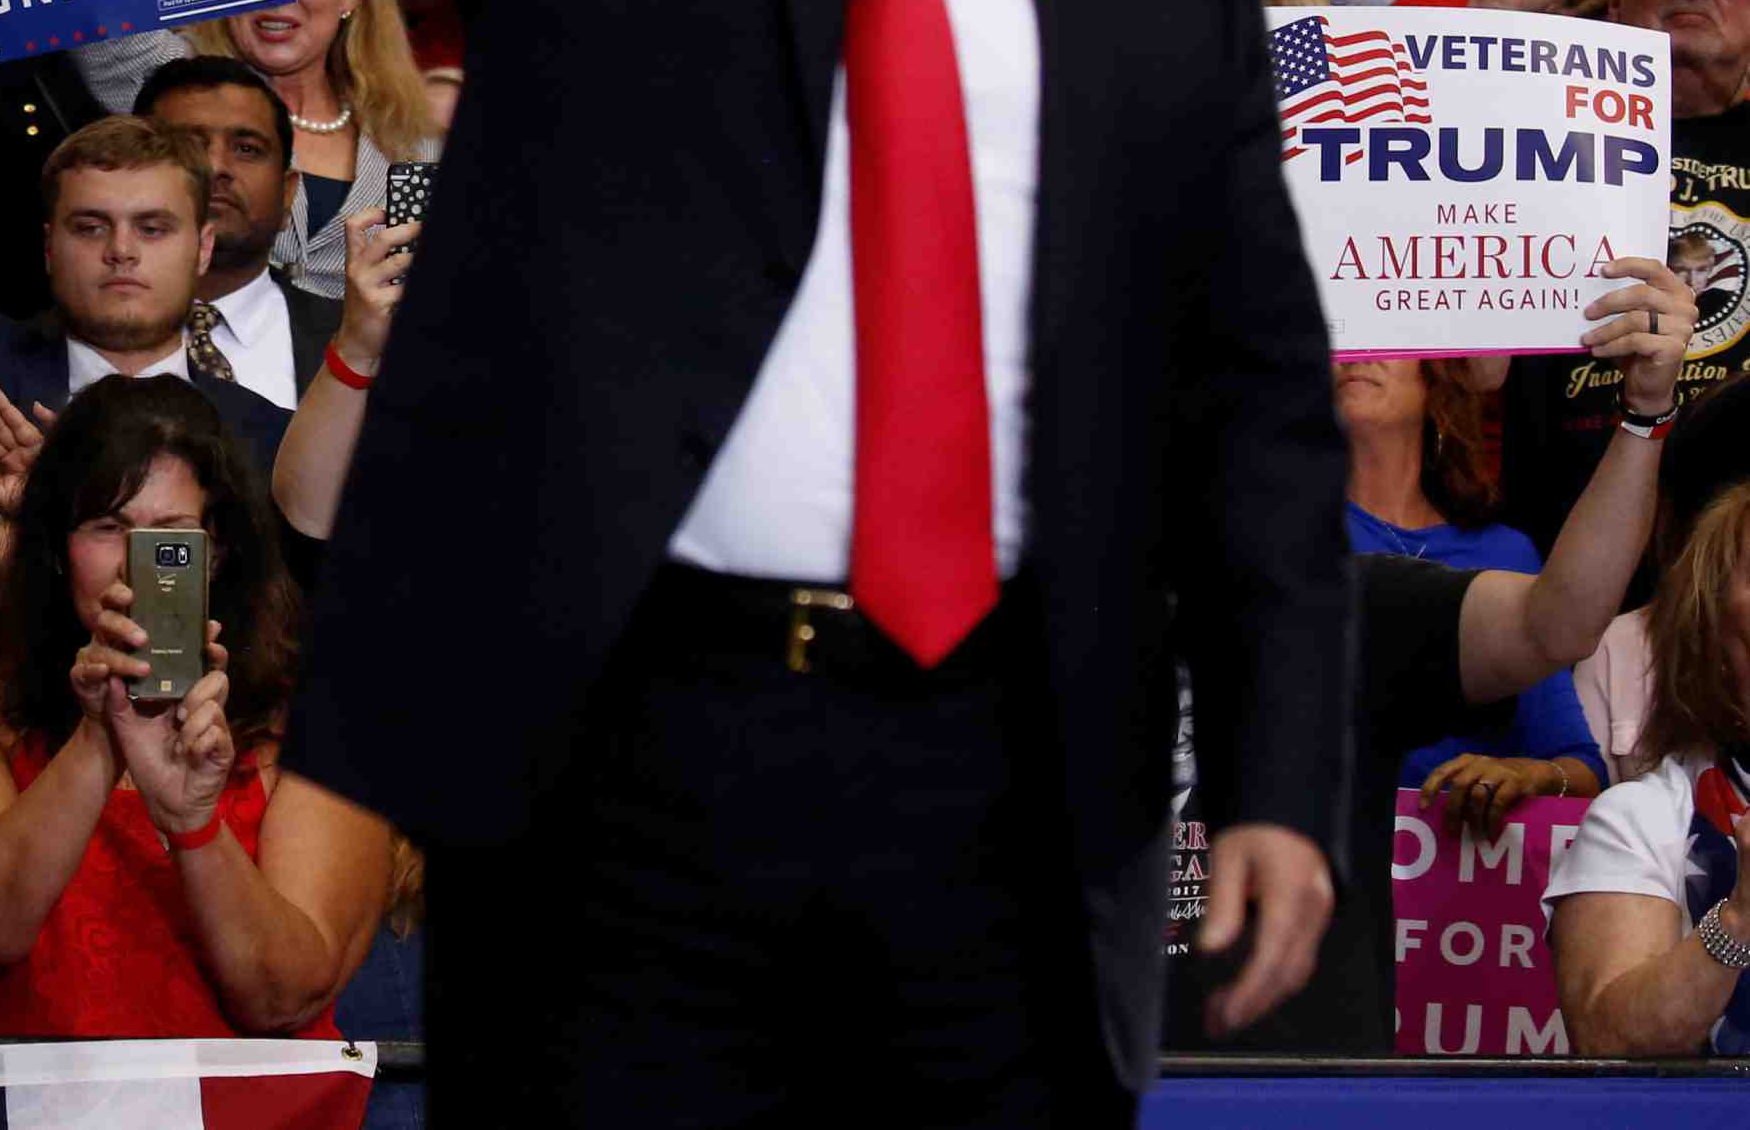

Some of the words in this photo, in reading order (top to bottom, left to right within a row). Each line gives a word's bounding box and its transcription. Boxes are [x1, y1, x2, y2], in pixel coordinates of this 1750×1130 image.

[1404, 34, 1657, 89] VETERANS
[1565, 84, 1655, 131] FOR
[1301, 126, 1660, 187] TRUMP
[1436, 203, 1518, 225] MAKE
[1329, 234, 1620, 280] AMERICA
[1375, 288, 1467, 311] GREAT
[1478, 288, 1580, 311] AGAIN!
[1395, 918, 1537, 968] FOR
